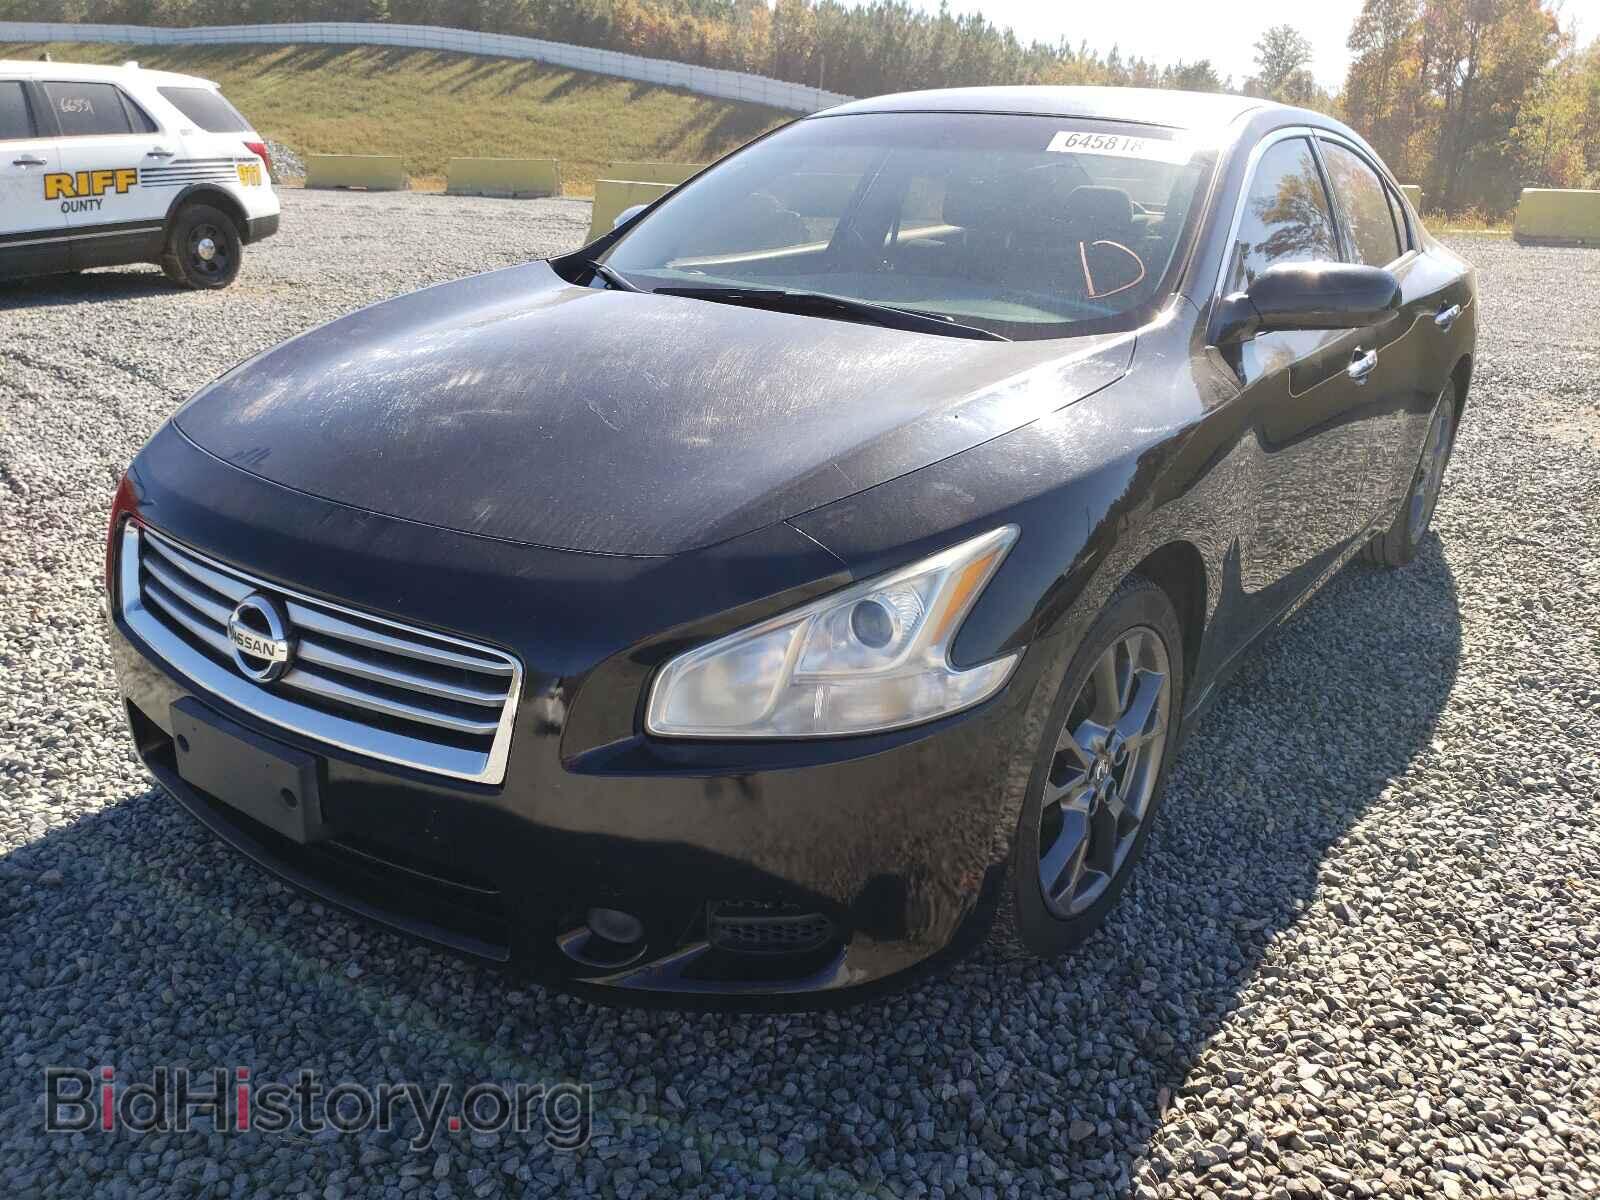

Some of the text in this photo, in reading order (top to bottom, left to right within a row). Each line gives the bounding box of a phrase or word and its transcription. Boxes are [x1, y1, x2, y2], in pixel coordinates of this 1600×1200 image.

[43, 168, 138, 200] RIFF
[237, 163, 262, 187] 911
[60, 199, 103, 214] OUNTY
[229, 624, 276, 657] NISSAN
